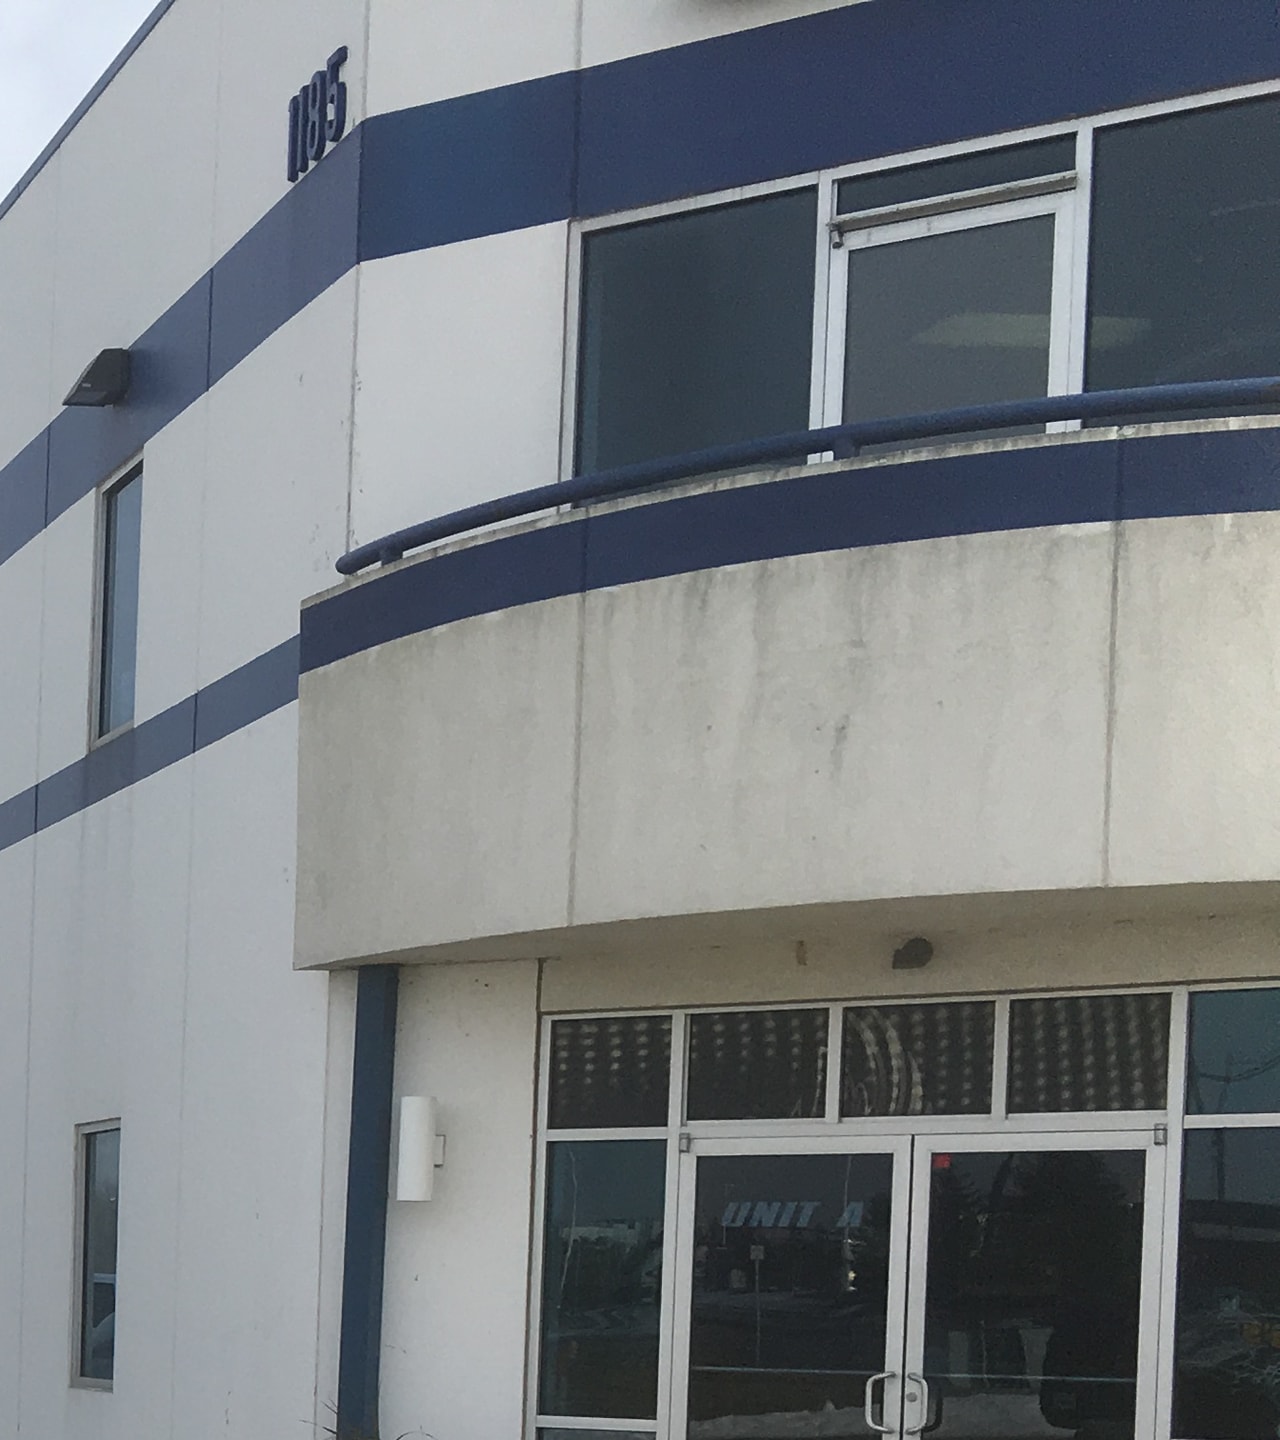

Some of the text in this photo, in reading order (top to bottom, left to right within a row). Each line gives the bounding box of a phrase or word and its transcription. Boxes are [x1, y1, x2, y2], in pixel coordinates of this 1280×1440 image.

[286, 45, 348, 183] 1185
[721, 1202, 864, 1227] UNIT A
